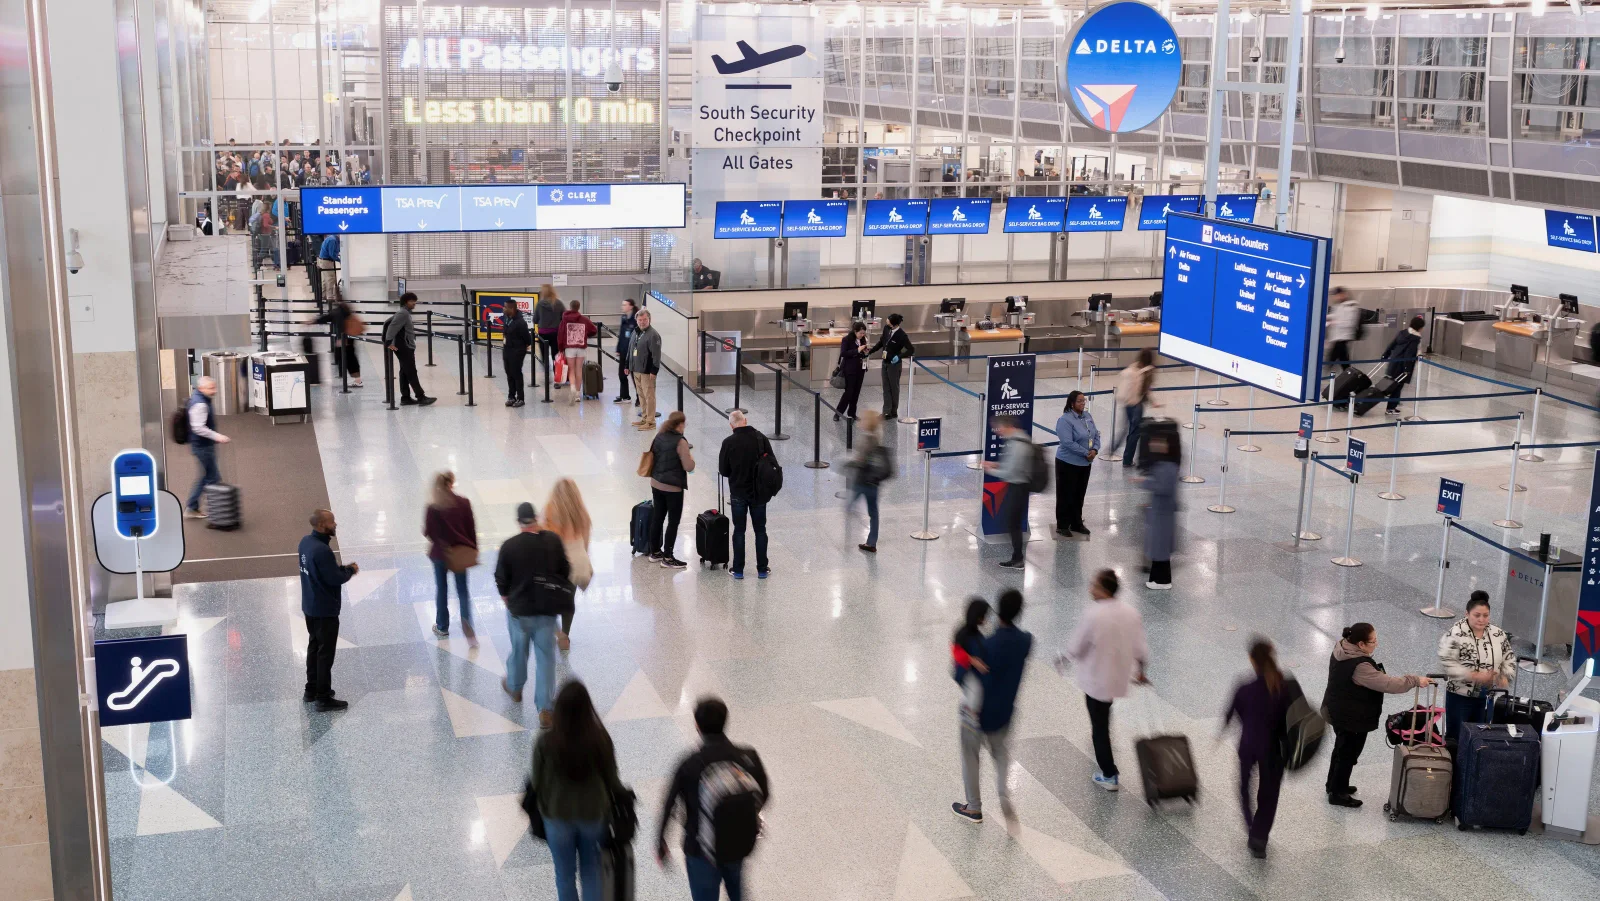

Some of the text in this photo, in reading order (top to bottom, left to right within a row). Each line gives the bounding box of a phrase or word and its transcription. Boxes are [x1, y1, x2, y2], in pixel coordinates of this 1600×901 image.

[1096, 39, 1157, 54] DELTA
[401, 38, 655, 77] All Passengers
[404, 98, 655, 124] Less than 10 min
[699, 105, 815, 123] South Security
[714, 127, 801, 145] Checkpoint
[722, 155, 793, 170] All Gates
[323, 195, 362, 205] Standard
[472, 197, 492, 208] TSA
[567, 192, 596, 200] CLEAR
[395, 198, 415, 209] TSA
[317, 206, 369, 216] Passengers
[1214, 231, 1269, 251] Check-in Counters
[1186, 251, 1200, 262] France
[1178, 262, 1191, 272] Delta
[1234, 262, 1257, 275] Lufthansa
[1243, 277, 1257, 289] Spirit
[1266, 269, 1293, 284] Aer Lingus
[1239, 289, 1256, 300] United
[1264, 282, 1292, 296] Air Canada
[1273, 297, 1290, 310] Alaska
[1265, 309, 1289, 322] American
[1262, 321, 1289, 336] Denver Air
[1265, 335, 1288, 349] Discover
[991, 403, 1030, 411] SELF-SERVICE
[920, 428, 938, 437] EXIT
[1349, 448, 1364, 460] EXIT
[1442, 489, 1461, 502] EXIT
[1518, 572, 1544, 588] DELTA
